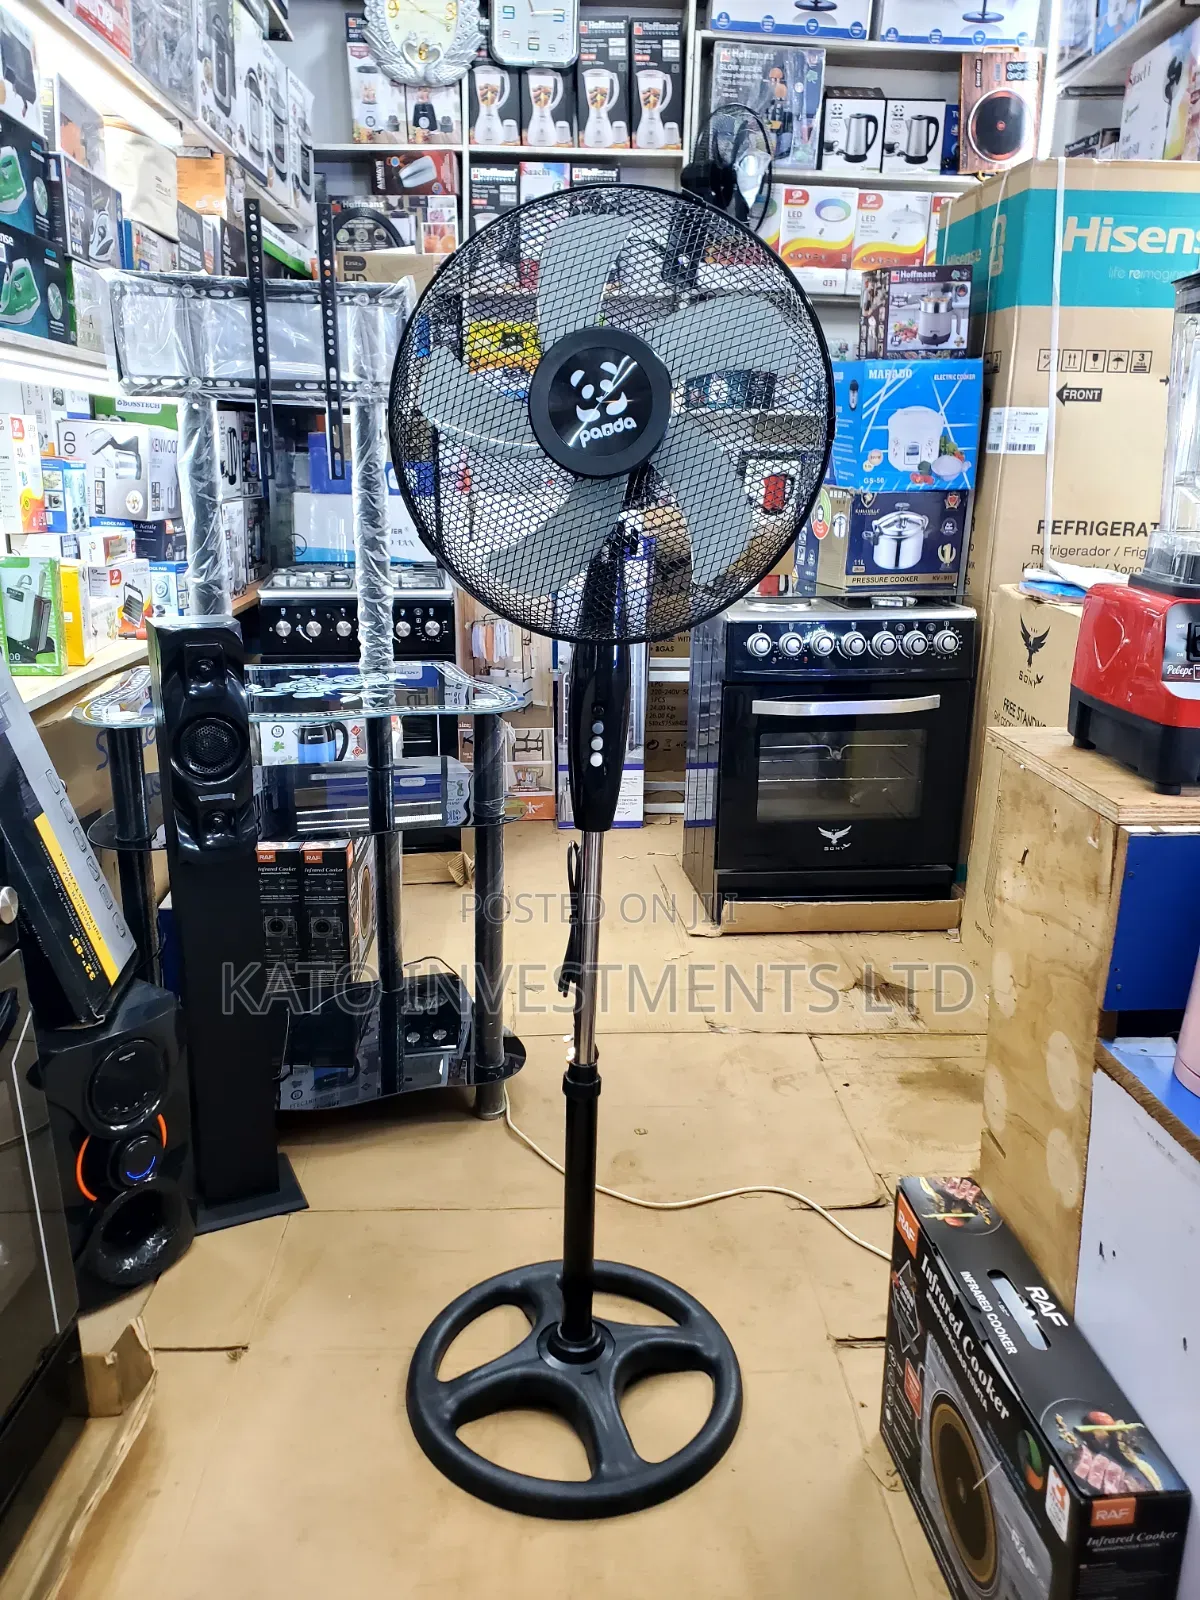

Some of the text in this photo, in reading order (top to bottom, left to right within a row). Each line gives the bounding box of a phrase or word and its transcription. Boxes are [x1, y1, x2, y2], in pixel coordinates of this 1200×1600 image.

[787, 210, 803, 218] LED
[900, 270, 938, 278] Hoffmans
[1138, 353, 1145, 362] 3
[1063, 389, 1101, 400] FRONT
[580, 416, 638, 448] panda
[1031, 544, 1112, 558] Refrigerador
[851, 576, 890, 584] PRESSURE
[889, 575, 919, 583] COOKER
[1002, 697, 1017, 719] FREE
[898, 1209, 916, 1243] RAF
[960, 1271, 1018, 1355] INFRARED COOKER
[1024, 1286, 1069, 1327] RAF
[920, 1253, 1010, 1420] Infrared Cooker
[1095, 1508, 1130, 1520] RAF
[1086, 1530, 1178, 1547] Infrared Cooker
